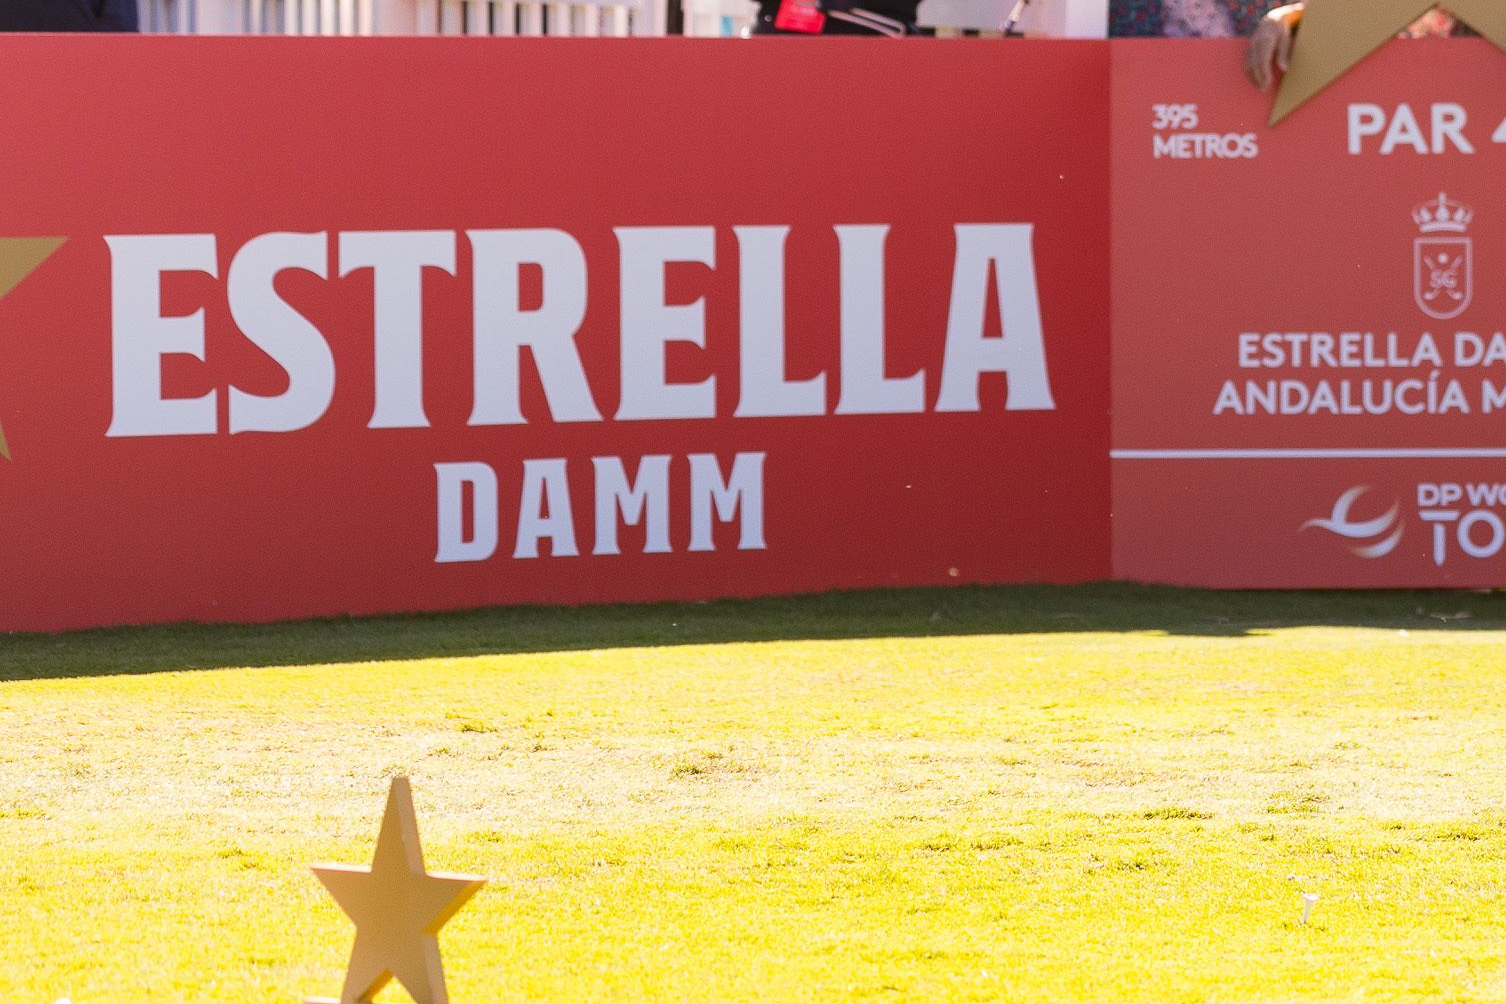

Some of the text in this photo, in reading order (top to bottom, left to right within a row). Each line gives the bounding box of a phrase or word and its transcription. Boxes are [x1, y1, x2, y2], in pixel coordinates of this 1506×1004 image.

[1151, 103, 1199, 130] 395
[1346, 101, 1475, 155] PAR
[1152, 132, 1259, 159] METROS
[103, 222, 1056, 438] ESTRELLA
[1237, 332, 1443, 368] ESTRELLA
[1211, 369, 1471, 415] ANDALUCÍA
[433, 451, 767, 564] DAMM
[1417, 483, 1463, 507] DP
